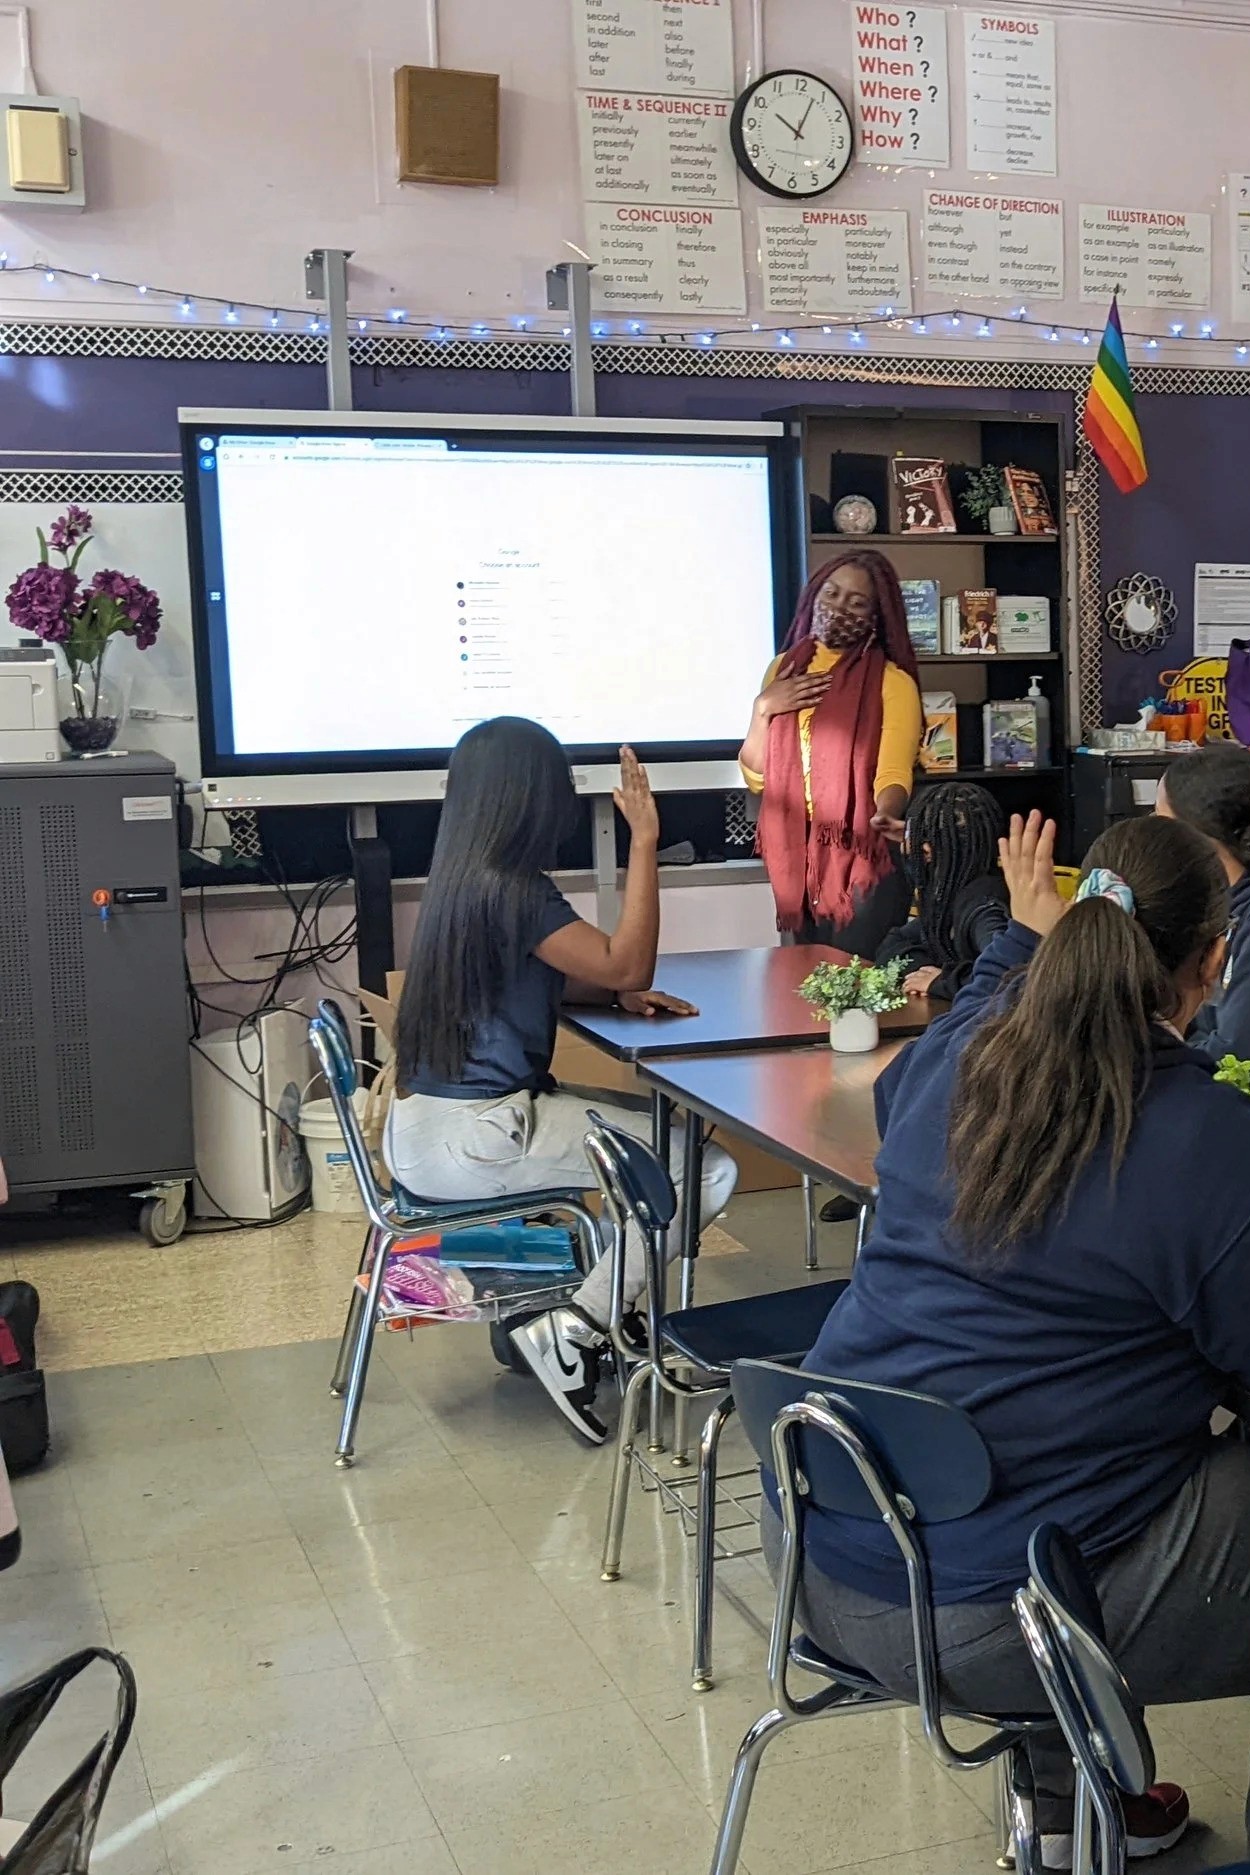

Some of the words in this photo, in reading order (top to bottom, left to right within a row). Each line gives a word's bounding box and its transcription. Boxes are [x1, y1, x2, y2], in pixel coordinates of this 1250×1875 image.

[663, 5, 682, 13] then
[587, 13, 620, 22] second
[857, 6, 899, 26] Who
[906, 11, 916, 28] ?
[598, 26, 635, 37] addition
[981, 18, 1039, 35] SYMBOLS
[665, 32, 683, 41] also
[857, 31, 907, 51] What
[914, 36, 923, 52] ?
[588, 39, 609, 48] later
[665, 45, 695, 56] before
[589, 52, 610, 62] after
[666, 58, 693, 70] finally
[859, 56, 913, 76] When
[920, 61, 929, 78] ?
[590, 66, 605, 76] last
[667, 73, 695, 85] during
[773, 81, 782, 93] 11
[796, 79, 807, 92] 12
[860, 80, 921, 101] Where
[928, 86, 937, 103] ?
[587, 96, 618, 109] TIME
[623, 99, 632, 110] &
[637, 100, 710, 116] SEQUENCE
[714, 105, 727, 116] II
[754, 96, 765, 108] 10
[592, 111, 623, 122] initially
[835, 110, 842, 122] 2
[861, 105, 902, 128] Why
[909, 108, 918, 125] ?
[668, 117, 706, 128] currently
[747, 118, 756, 130] 9
[593, 126, 639, 137] previously
[669, 130, 697, 138] earlier
[594, 139, 634, 150] presently
[837, 136, 844, 149] 3
[862, 130, 903, 148] How
[910, 133, 919, 150] ?
[670, 144, 717, 153] meanwhile
[752, 144, 759, 158] 8
[595, 151, 615, 160] later
[671, 156, 712, 169] ultimately
[827, 158, 835, 170] 4
[606, 165, 621, 175] last
[684, 171, 704, 179] soon
[768, 166, 775, 178] 7
[596, 179, 649, 192] additionally
[788, 176, 796, 188] 6
[811, 174, 819, 186] 5
[672, 184, 716, 195] eventually
[930, 194, 980, 208] CHANGE
[983, 198, 998, 209] OF
[1001, 200, 1059, 214] DIRECTION
[617, 209, 712, 224] CONCLUSION
[928, 205, 963, 217] however
[999, 212, 1012, 220] but
[802, 212, 867, 225] EMPHASIS
[1108, 210, 1185, 226] ILLUSTRATION
[611, 223, 657, 232] conclusion
[676, 224, 702, 237] finally
[766, 224, 809, 235] especially
[845, 227, 892, 238] particularly
[928, 223, 964, 235] although
[1096, 223, 1129, 233] example
[1148, 226, 1190, 238] particularly
[1000, 230, 1011, 238] yet
[611, 239, 643, 251] closing
[677, 241, 716, 252] therefore
[777, 238, 817, 246] particular
[950, 241, 977, 252] though
[1106, 240, 1139, 248] example
[1169, 242, 1204, 252] illustration
[768, 249, 808, 259] obviously
[1000, 245, 1028, 254] instead
[678, 258, 695, 267] thus
[847, 252, 877, 262] notably
[937, 258, 969, 266] contrast
[1120, 256, 1138, 264] point
[1148, 257, 1175, 268] namely
[613, 258, 653, 268] summary
[769, 261, 796, 269] above
[847, 262, 866, 272] keep
[879, 264, 898, 272] mind
[1025, 263, 1056, 273] contrary
[625, 273, 648, 282] result
[952, 273, 969, 281] other
[971, 274, 989, 283] hand
[1097, 268, 1127, 278] instance
[680, 275, 709, 286] clearly
[791, 274, 835, 284] importantly
[848, 274, 894, 284] furthermore
[1010, 278, 1042, 289] opposing
[605, 291, 663, 302] consequently
[770, 286, 807, 296] primarily
[848, 287, 900, 299] undoubtedly
[1156, 289, 1192, 298] particular
[680, 291, 702, 303] lastly
[771, 298, 807, 308] certainly
[899, 465, 942, 483] VICTORY
